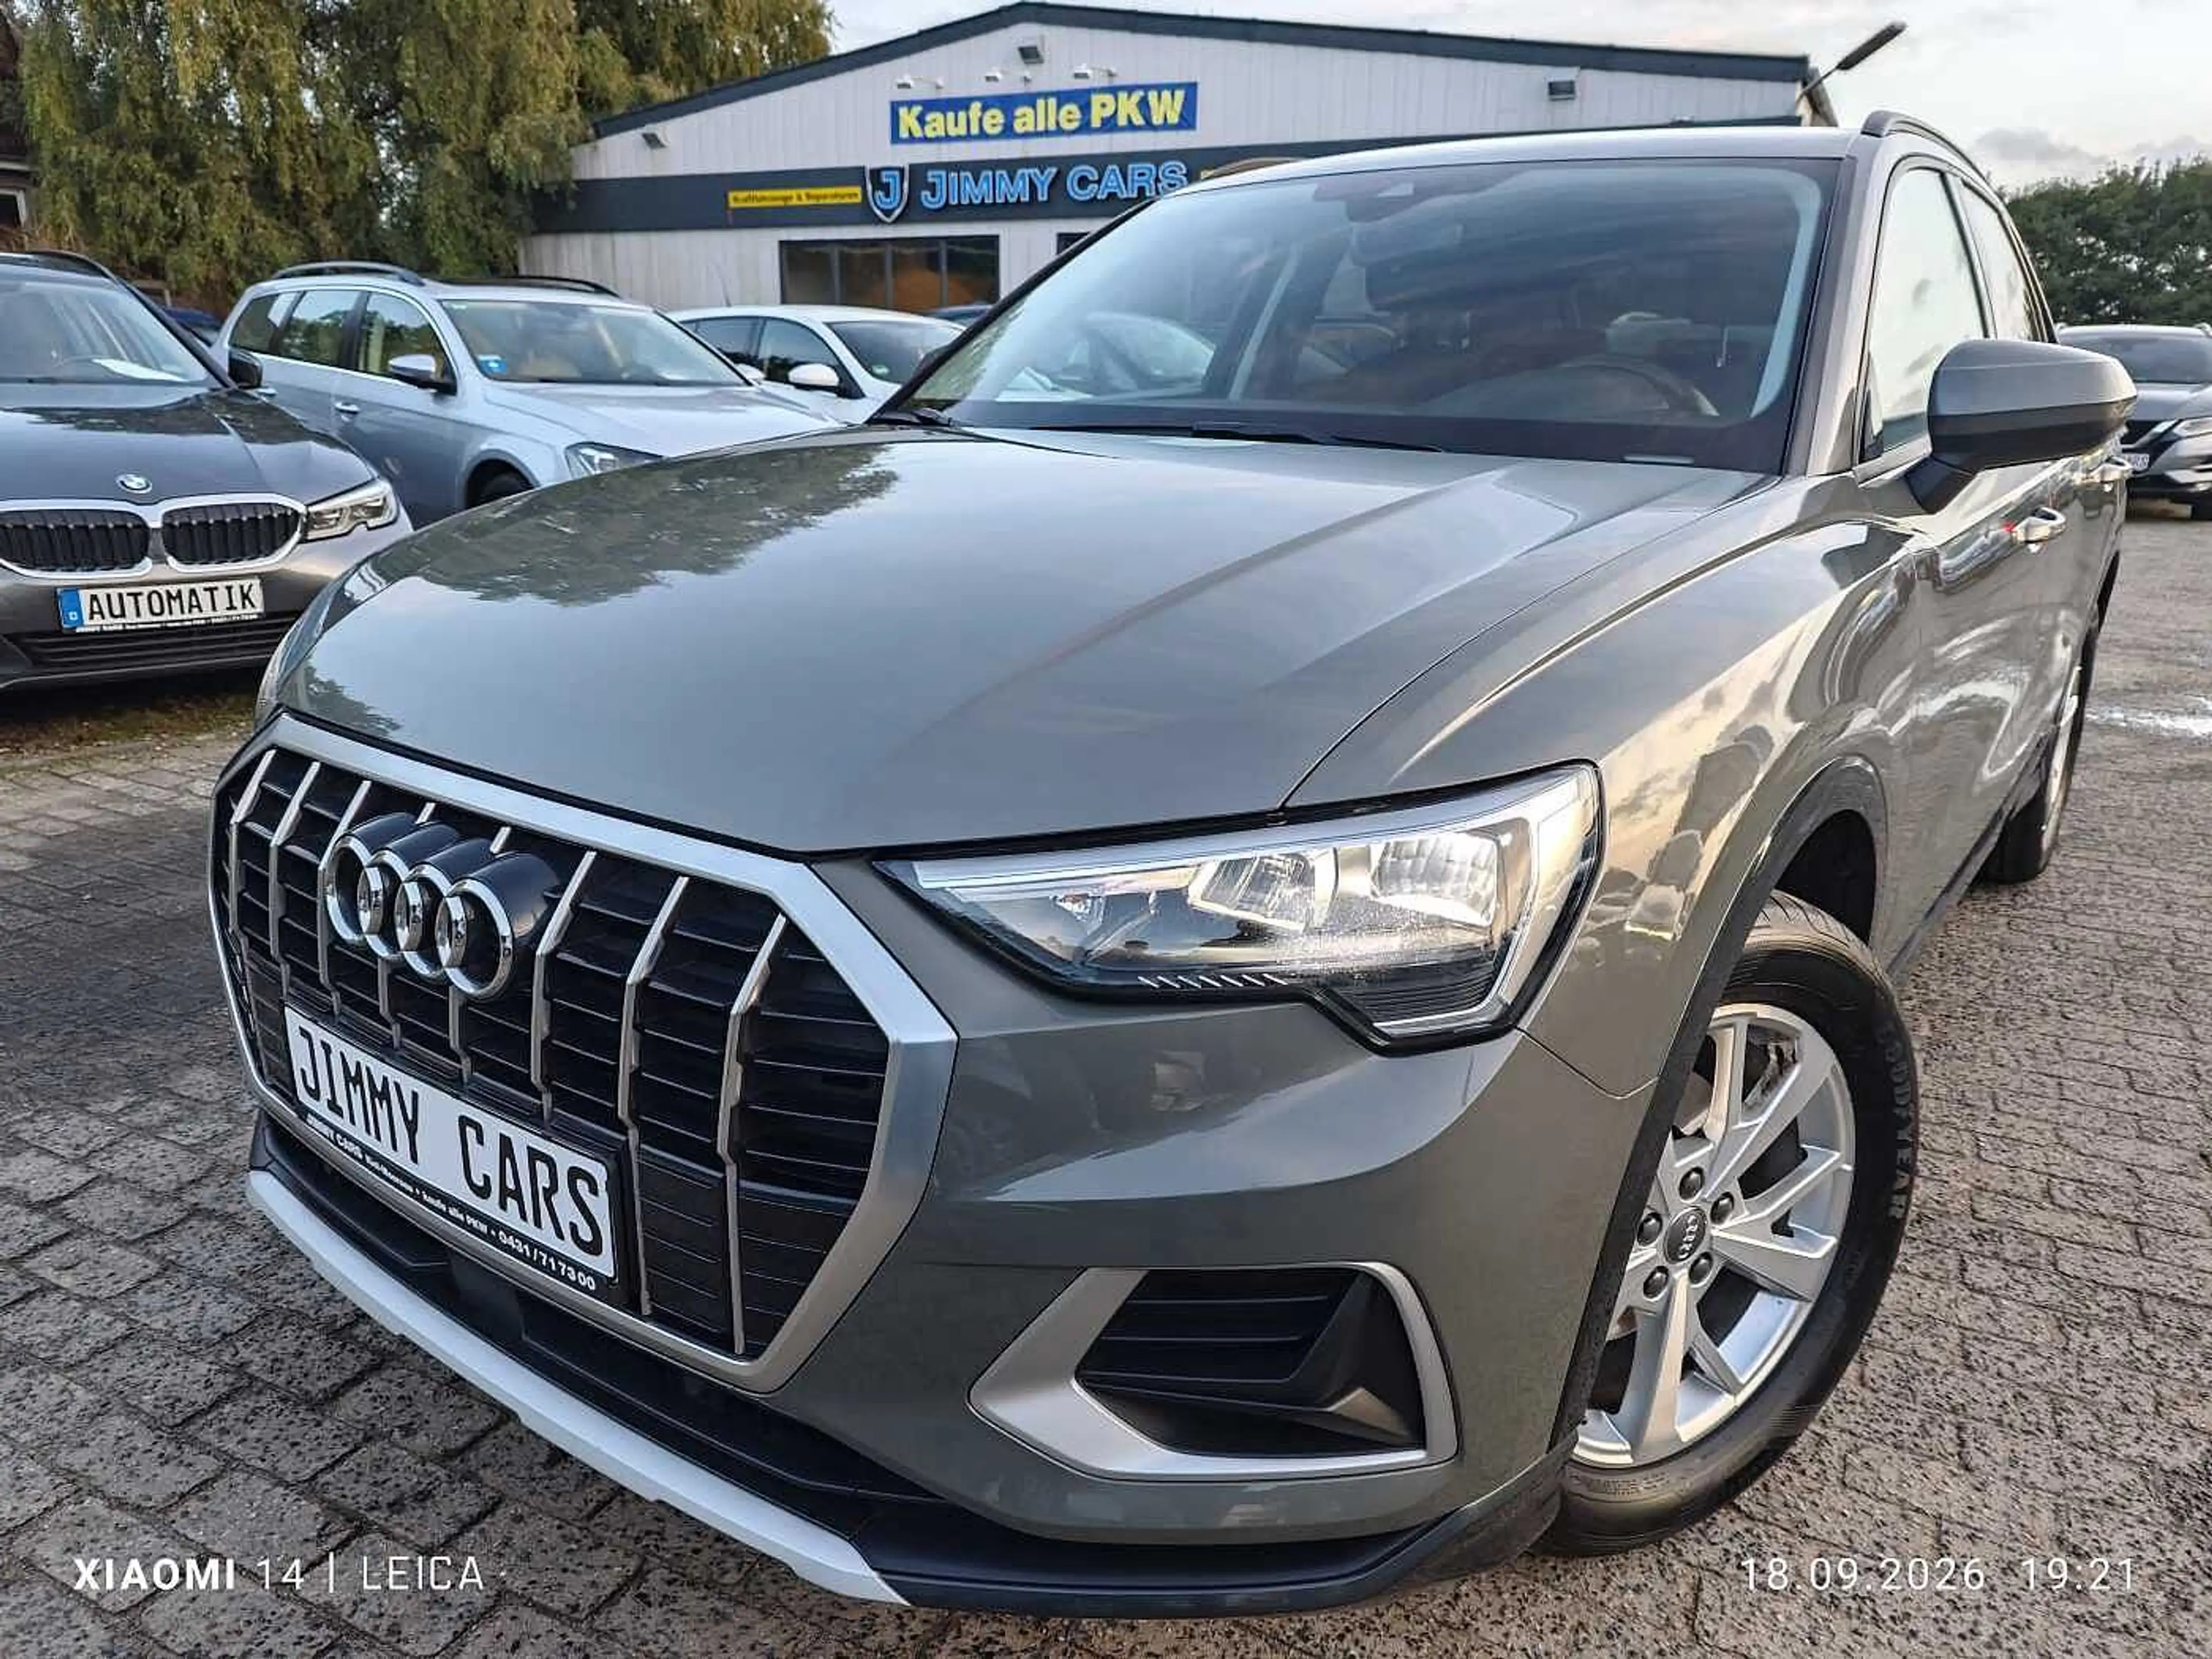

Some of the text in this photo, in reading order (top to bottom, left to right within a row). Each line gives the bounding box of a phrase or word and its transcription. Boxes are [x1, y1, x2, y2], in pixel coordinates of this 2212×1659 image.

[899, 89, 1185, 139] Kaufe alle PKW
[923, 161, 1188, 210] JIMMY CARS
[88, 583, 256, 620] AUTOMATIK
[298, 1025, 604, 1256] JIMMY CARS
